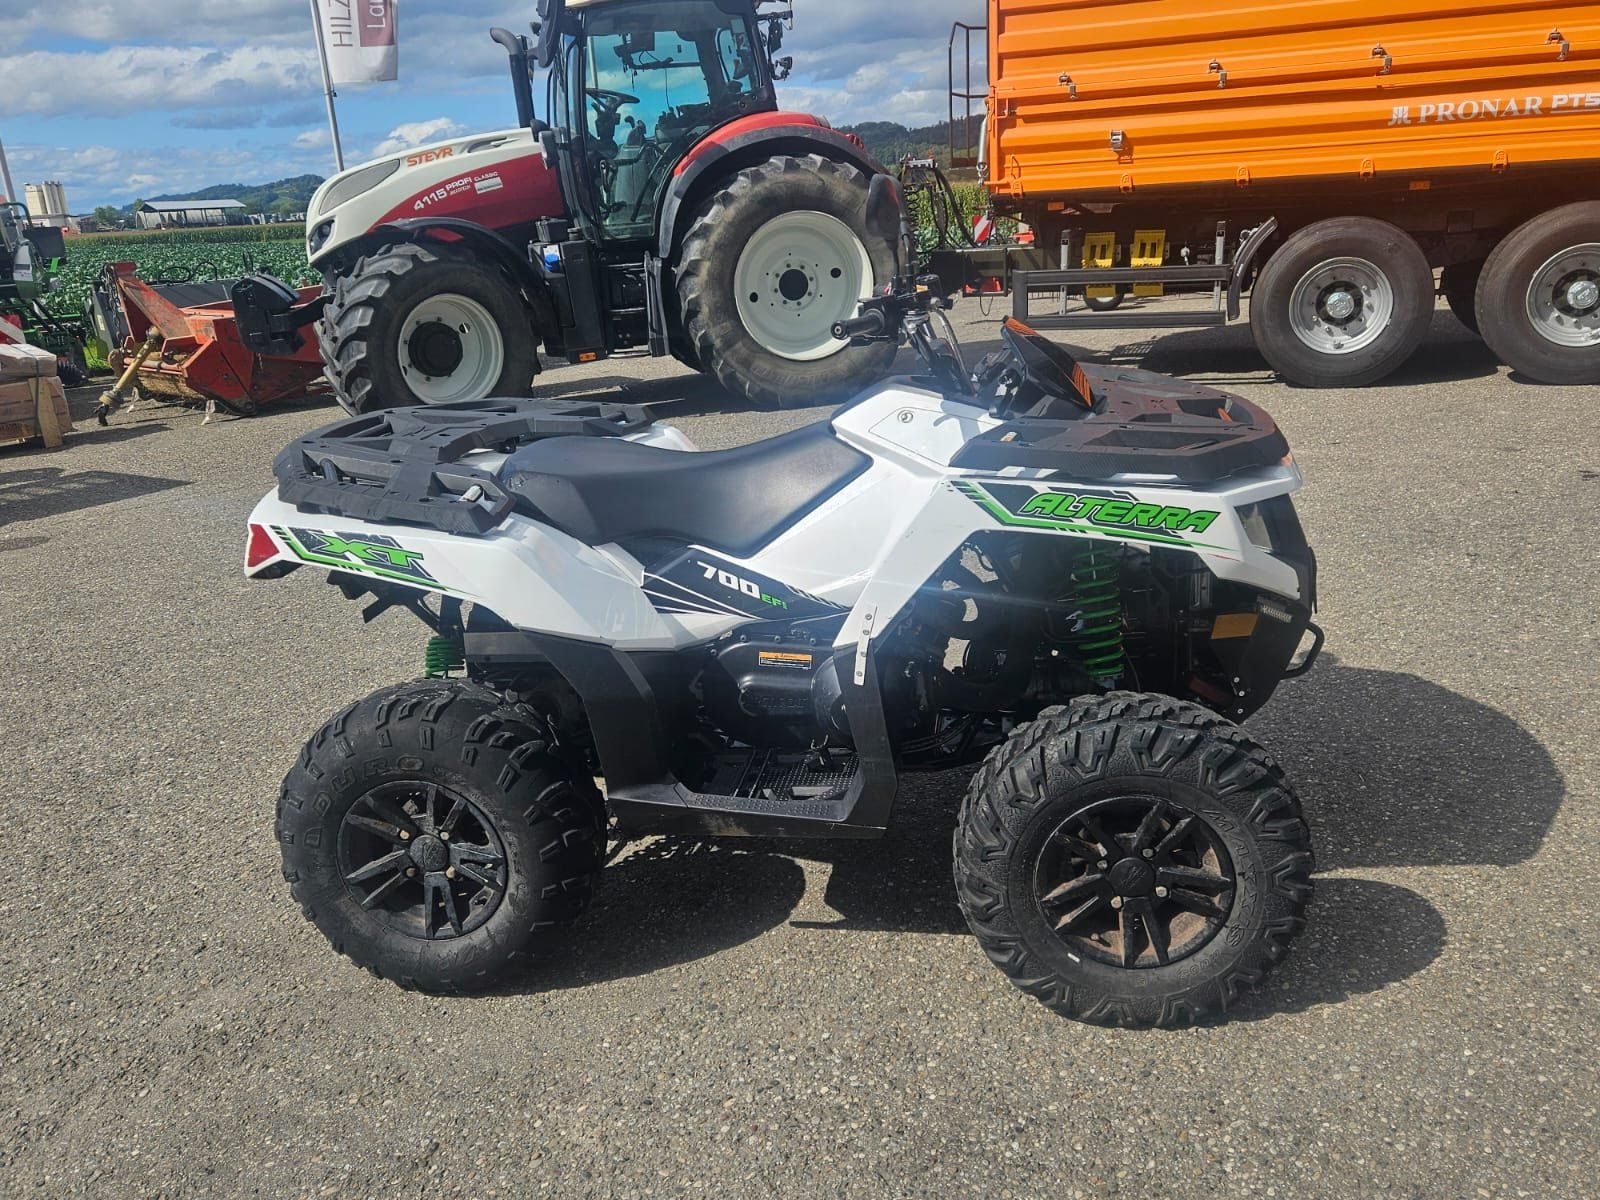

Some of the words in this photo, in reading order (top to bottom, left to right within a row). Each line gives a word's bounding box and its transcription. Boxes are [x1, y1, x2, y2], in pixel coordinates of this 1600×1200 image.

[366, 0, 386, 28] La
[1417, 96, 1543, 123] PRONAR
[406, 147, 453, 167] STEYR
[413, 188, 448, 210] 4115
[445, 176, 473, 191] PROFI
[1018, 492, 1221, 534] ALTERRA
[312, 533, 425, 569] XT
[697, 561, 760, 599] 700
[760, 592, 789, 610] EFI
